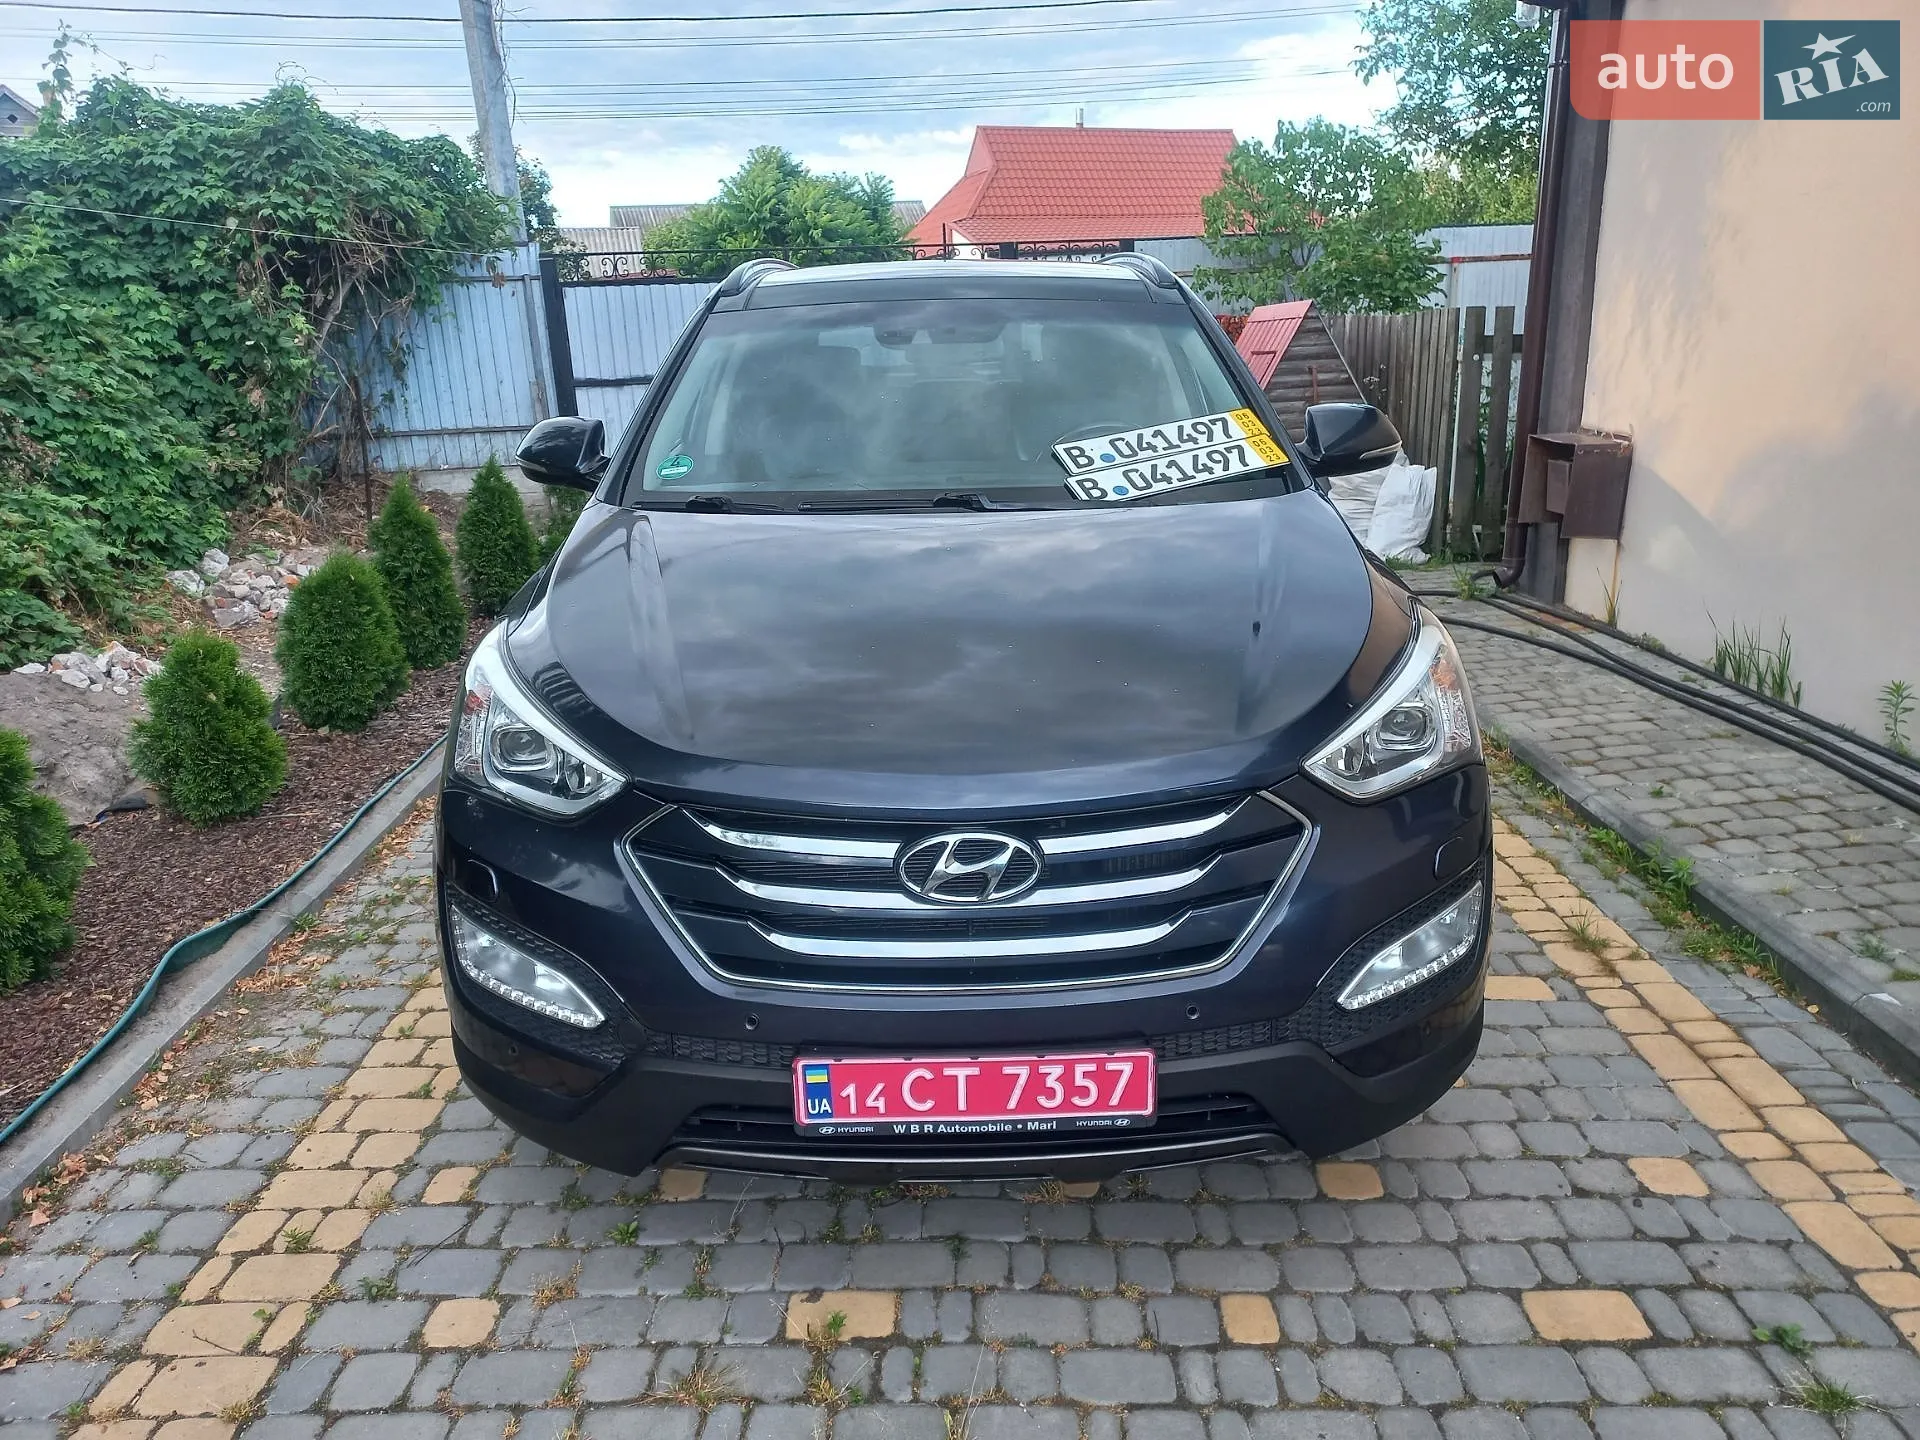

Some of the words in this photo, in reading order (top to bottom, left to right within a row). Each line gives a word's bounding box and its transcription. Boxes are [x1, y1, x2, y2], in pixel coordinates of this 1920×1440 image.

[1063, 446, 1096, 470] B
[1108, 416, 1233, 460] 041497
[1075, 477, 1108, 501] B
[1122, 444, 1250, 492] 041497
[839, 1082, 886, 1115] 14
[900, 1067, 981, 1112] CT
[1001, 1062, 1134, 1111] 7357
[807, 1098, 832, 1115] UA
[1076, 1119, 1113, 1127] HYUNDAI
[893, 1124, 907, 1134] W
[911, 1123, 920, 1134] B
[923, 1123, 934, 1133] R
[937, 1122, 1012, 1133] Automobile
[1027, 1120, 1057, 1130] Marl
